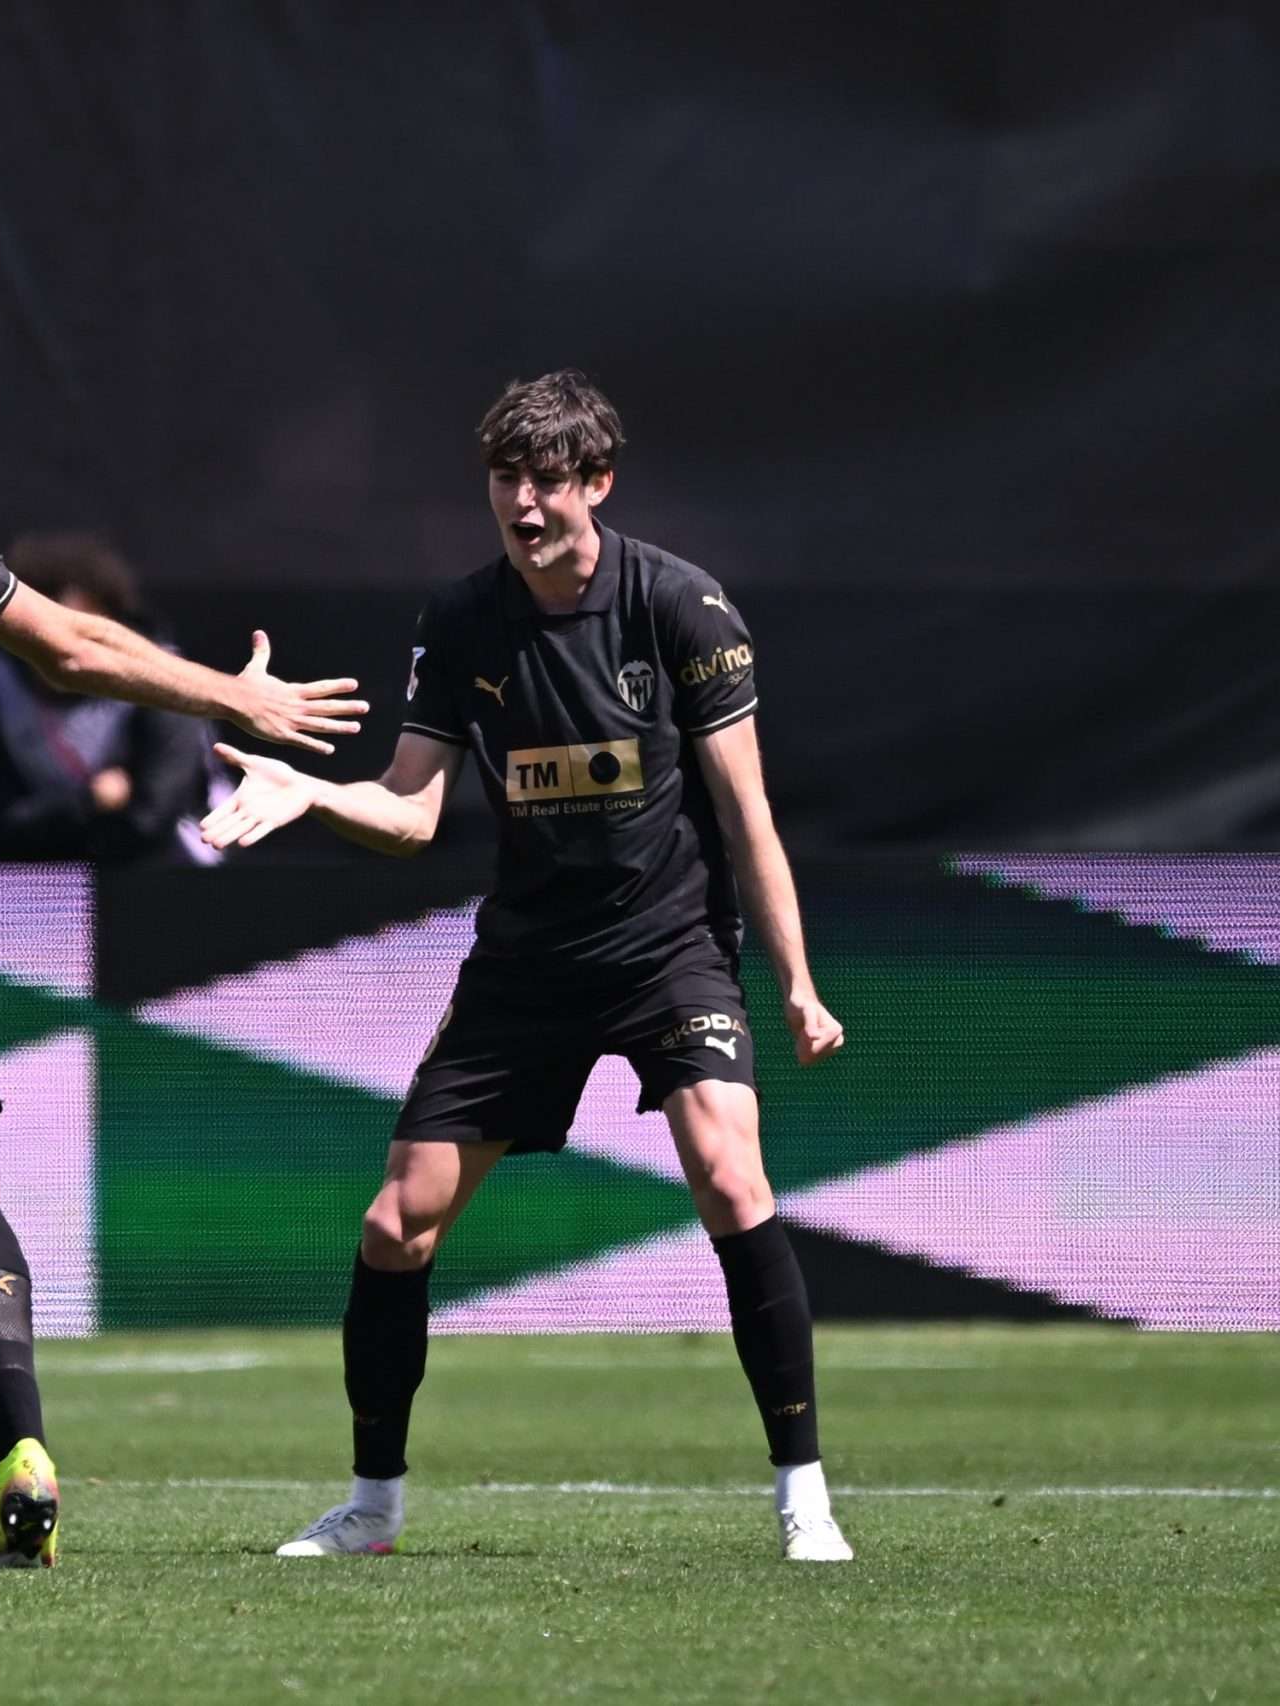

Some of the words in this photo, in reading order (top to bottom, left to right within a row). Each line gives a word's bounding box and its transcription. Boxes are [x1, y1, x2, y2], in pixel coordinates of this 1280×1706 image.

[680, 643, 753, 686] divina
[515, 761, 560, 790] TM
[510, 805, 529, 817] TM
[531, 803, 560, 817] Real
[563, 800, 601, 815] Estate
[604, 797, 646, 811] Group
